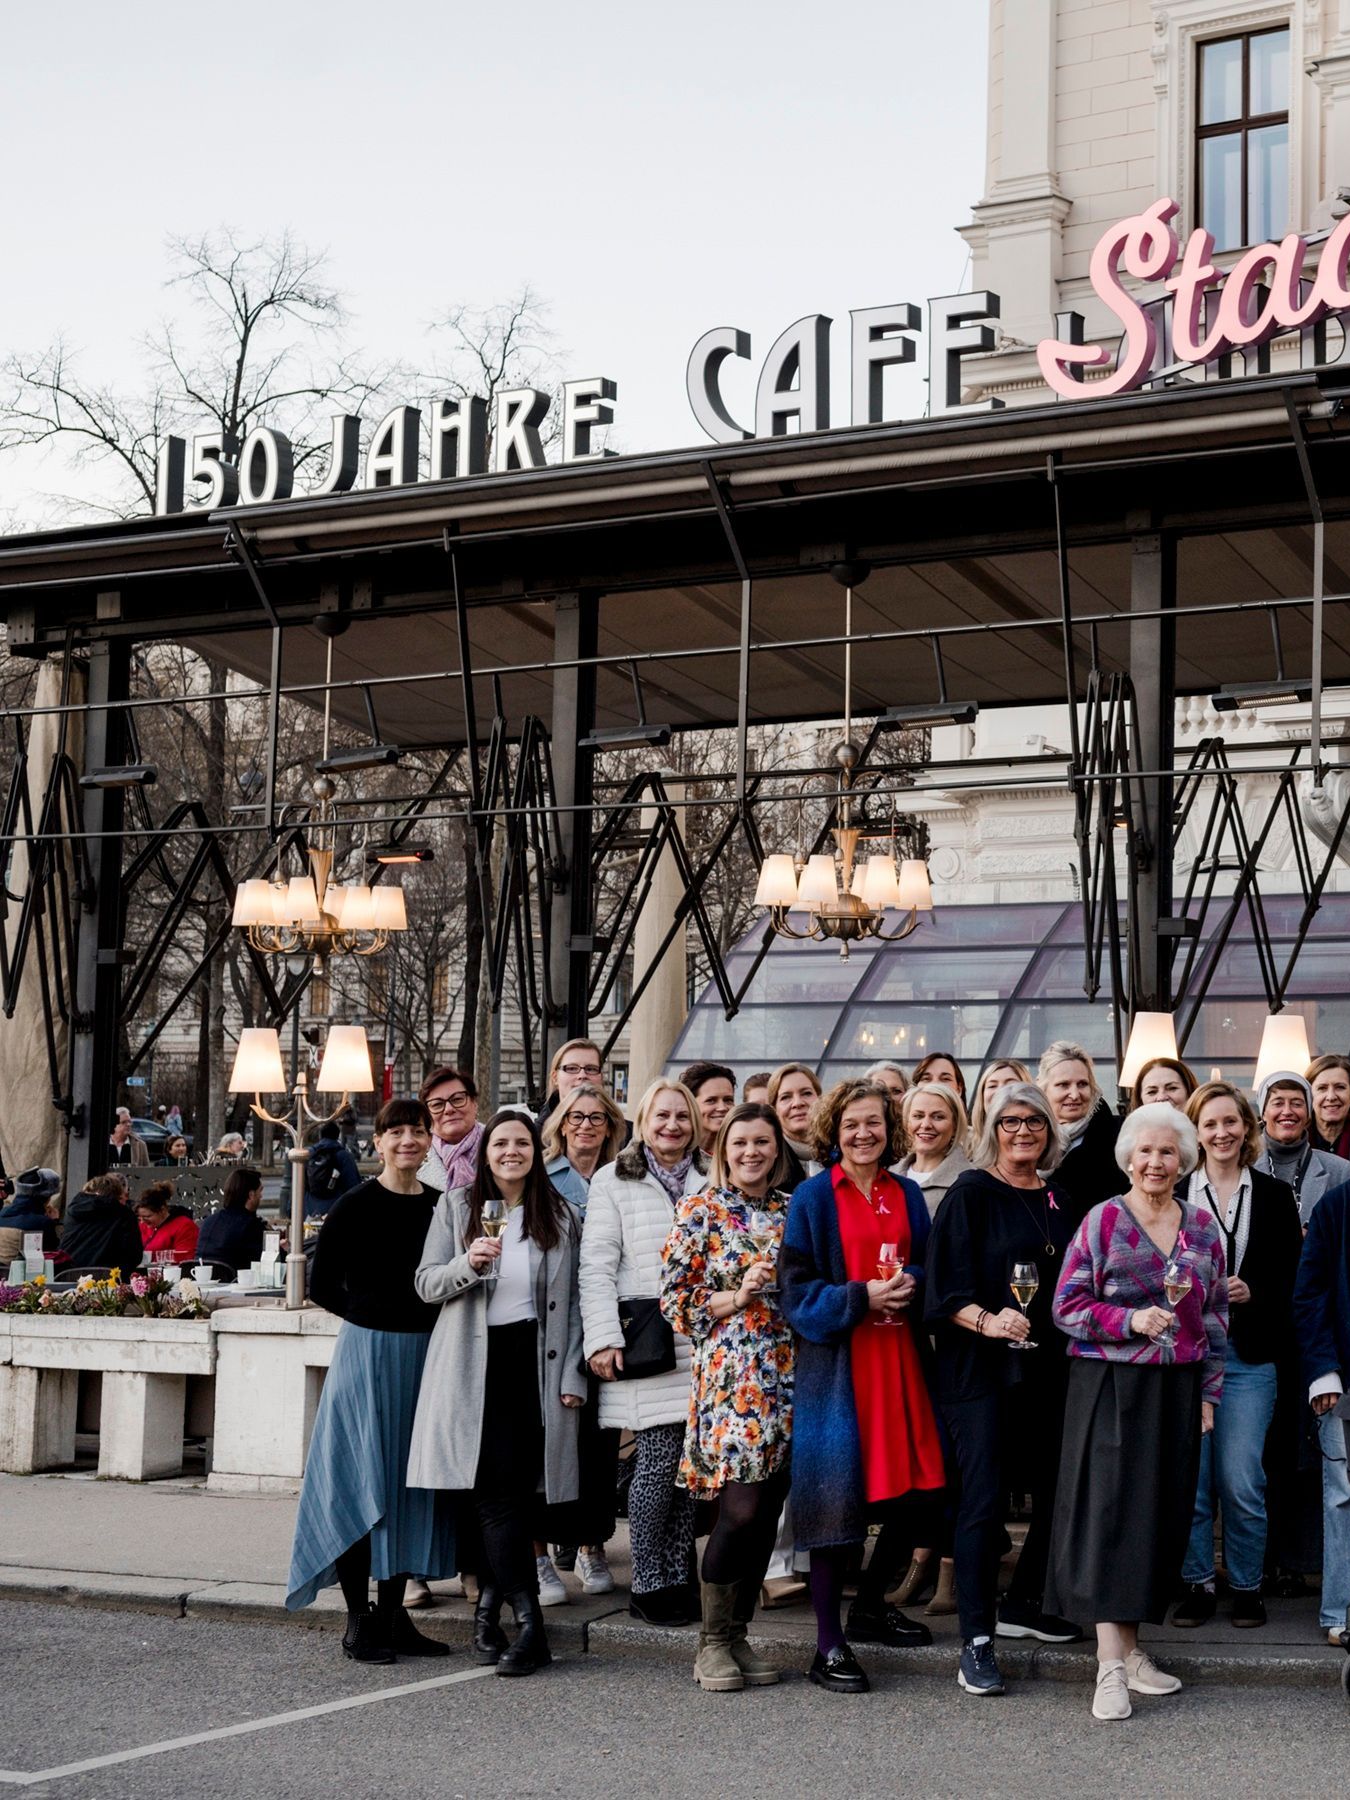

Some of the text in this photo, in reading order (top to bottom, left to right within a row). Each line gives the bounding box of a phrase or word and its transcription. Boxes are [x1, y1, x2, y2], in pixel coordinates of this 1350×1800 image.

[685, 290, 1005, 443] CAFE
[156, 376, 620, 517] 150 JAHRE
